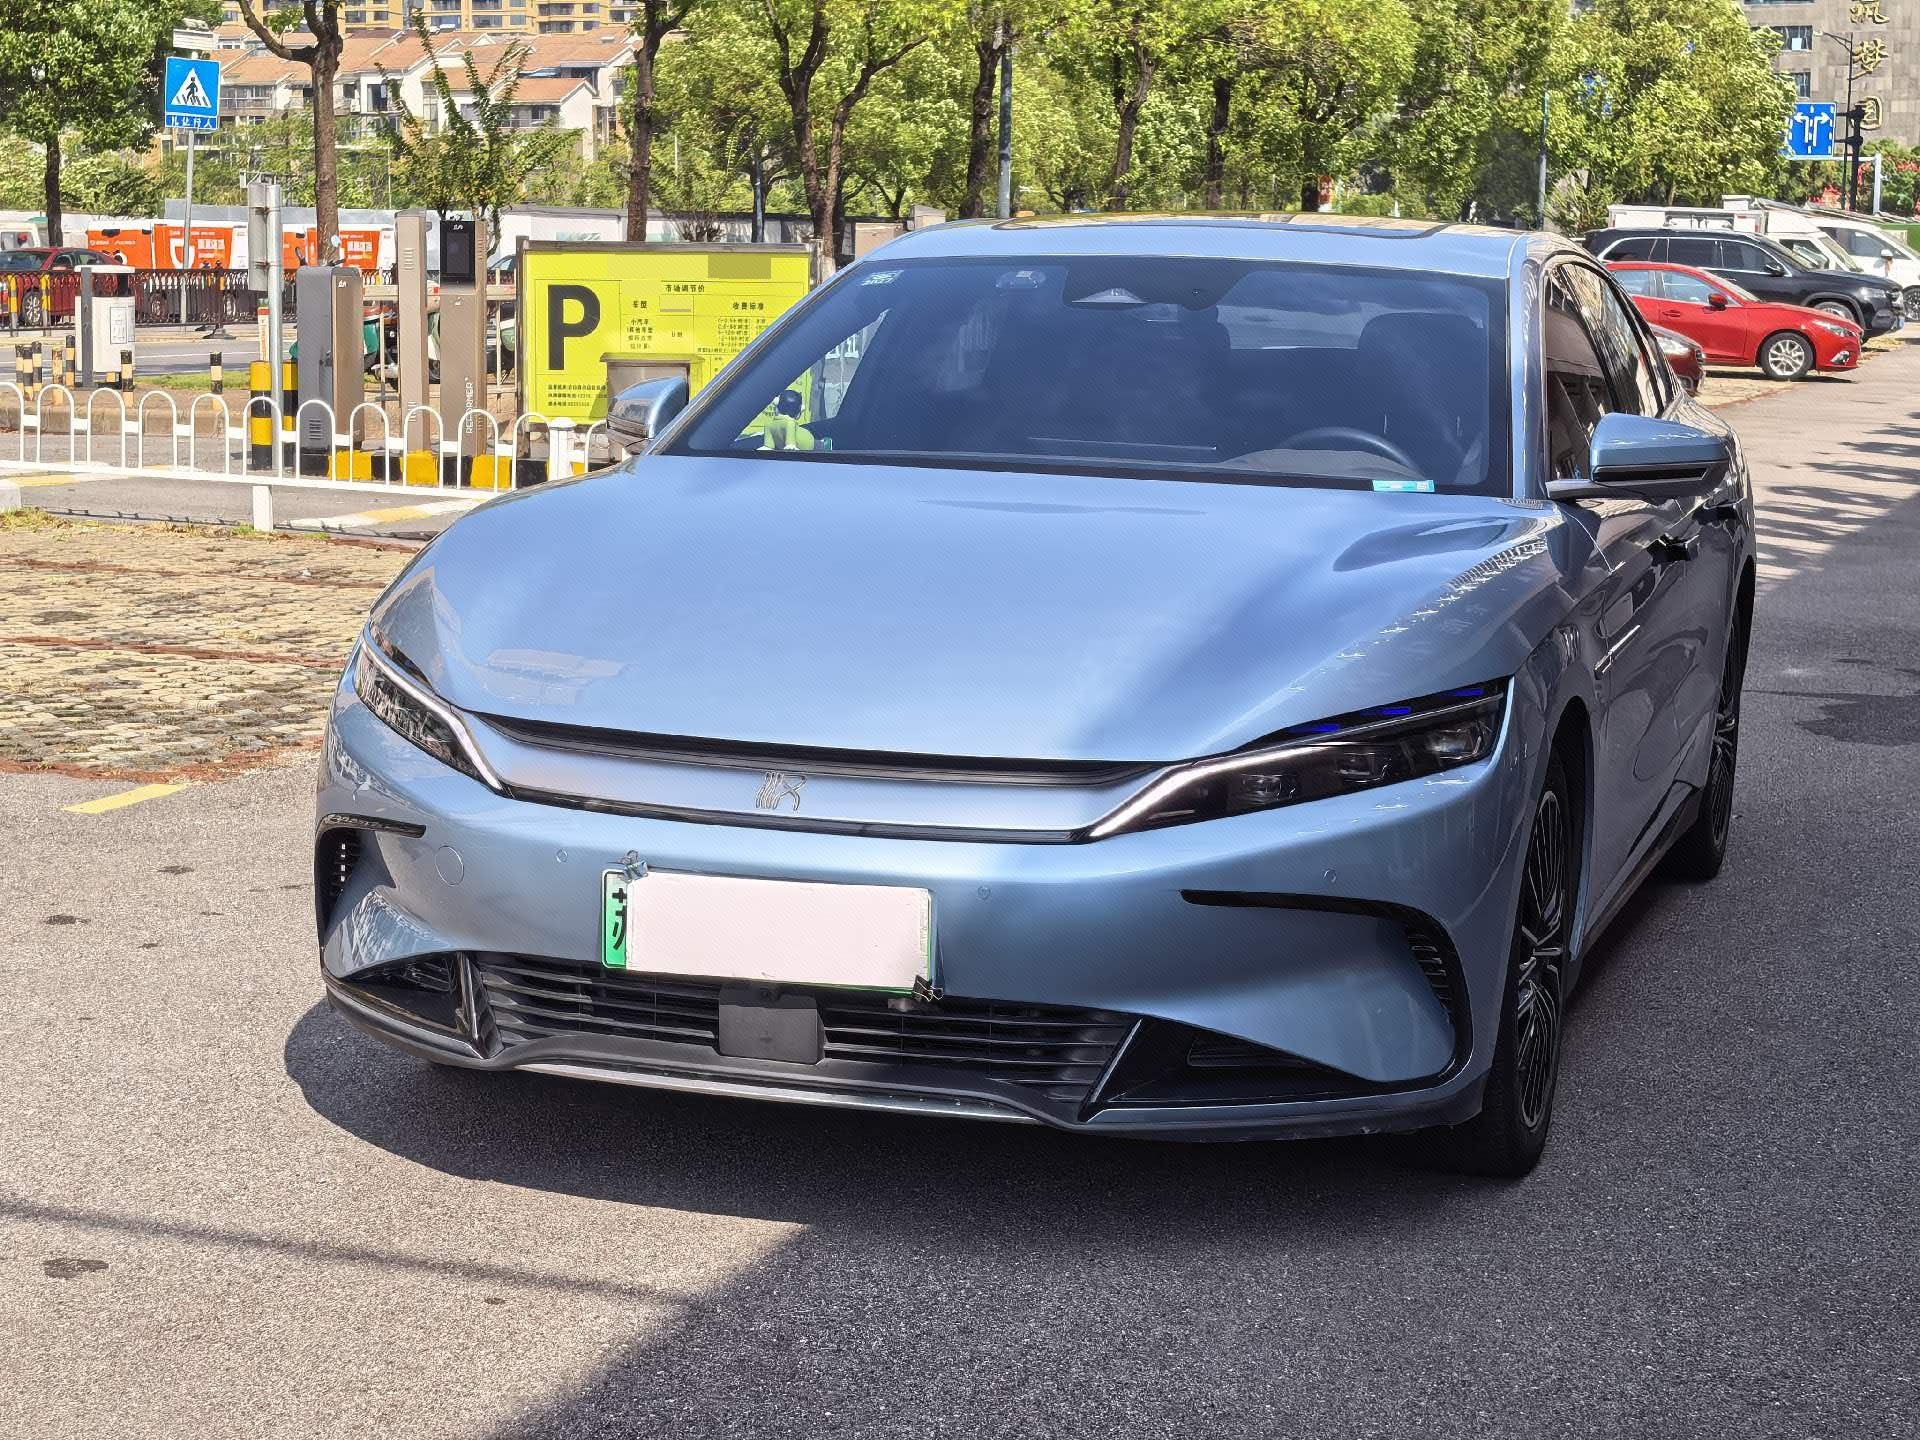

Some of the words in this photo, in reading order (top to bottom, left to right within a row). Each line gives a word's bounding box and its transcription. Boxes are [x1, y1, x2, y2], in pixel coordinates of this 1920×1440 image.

[547, 284, 601, 370] P
[732, 302, 764, 310] 收费标准
